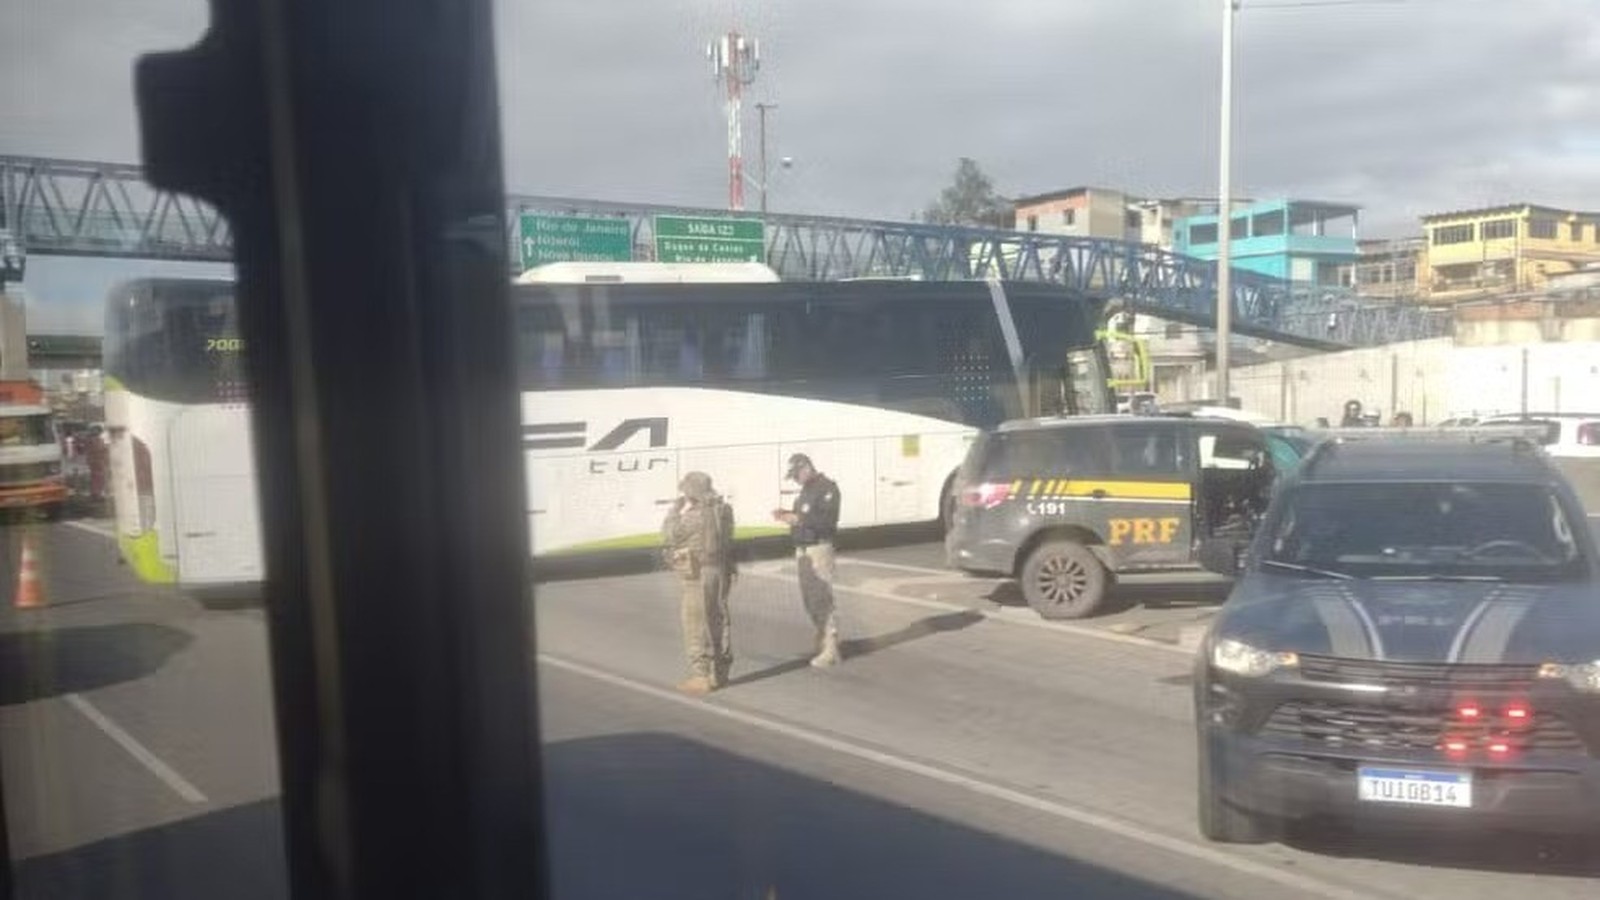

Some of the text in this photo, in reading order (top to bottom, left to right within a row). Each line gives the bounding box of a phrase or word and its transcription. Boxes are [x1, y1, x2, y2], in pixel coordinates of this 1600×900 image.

[585, 221, 629, 236] Janeiro
[590, 457, 669, 474] tur
[1037, 502, 1066, 516] 191
[1108, 517, 1181, 546] PRF
